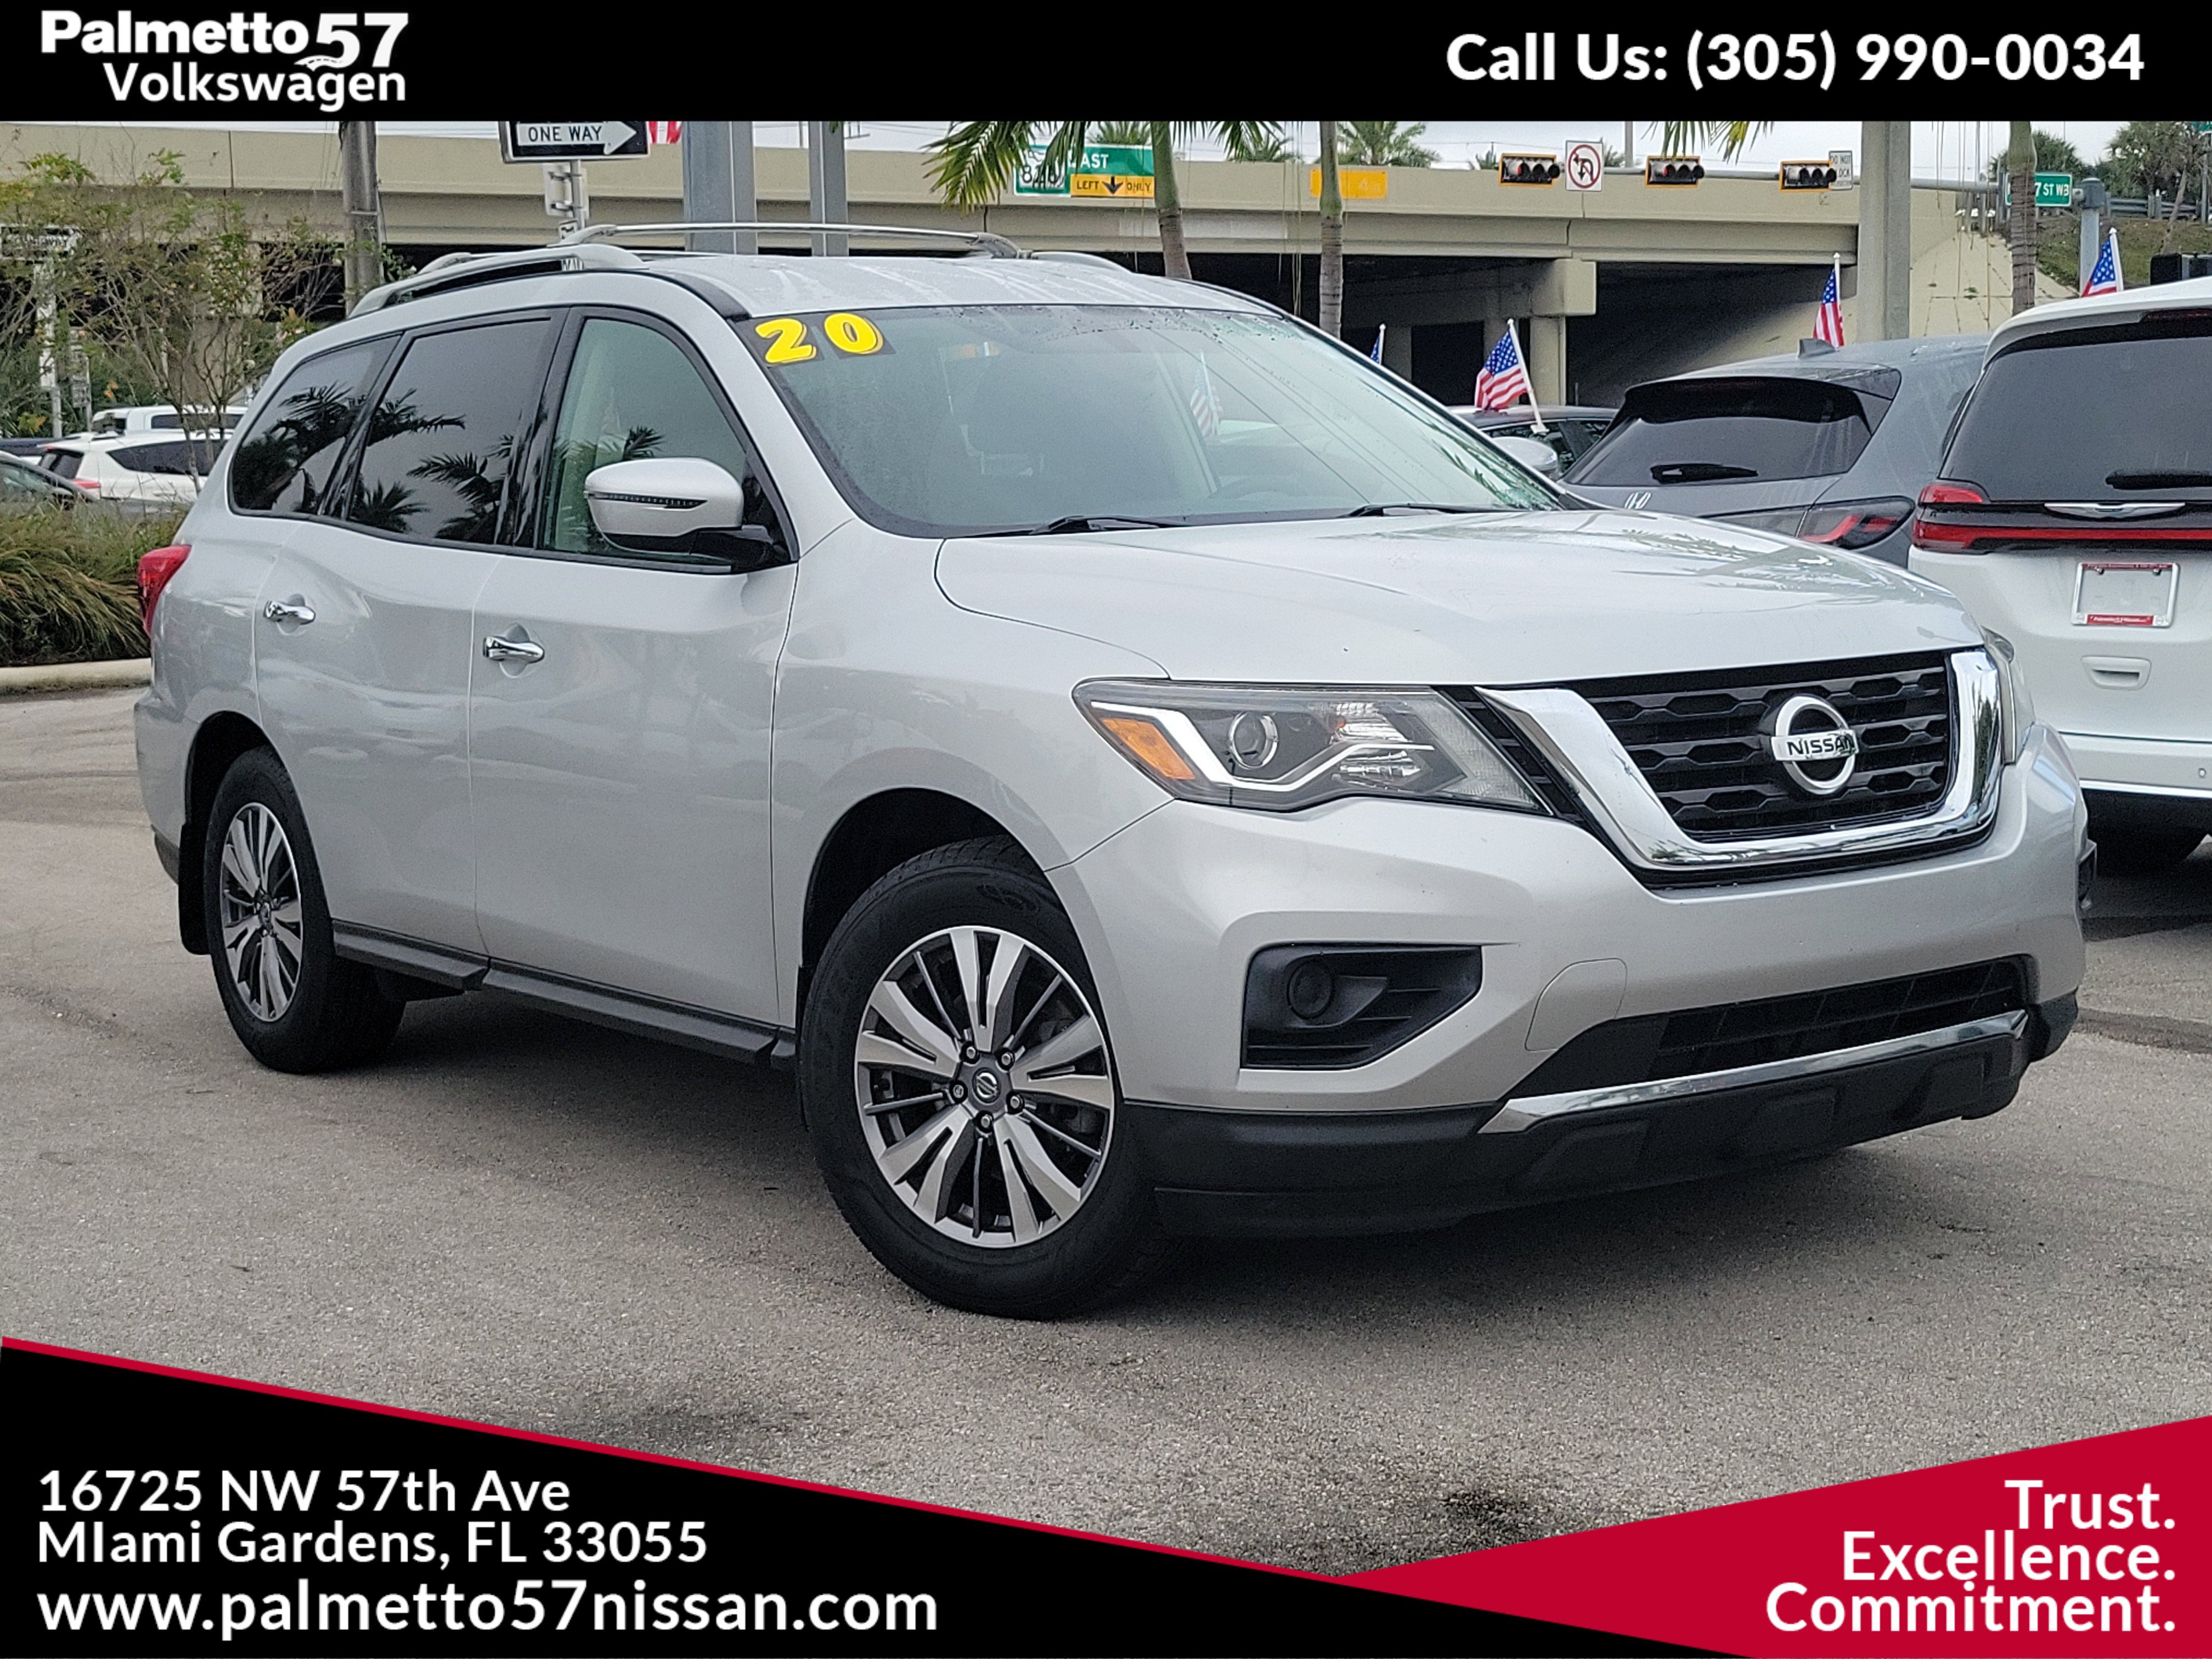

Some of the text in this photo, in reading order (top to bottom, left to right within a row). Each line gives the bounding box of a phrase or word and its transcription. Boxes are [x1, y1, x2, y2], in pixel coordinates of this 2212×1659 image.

[528, 125, 602, 143] ONE WAY
[1076, 180, 1150, 192] LEFT ONLY
[2042, 183, 2054, 196] ST
[2056, 184, 2069, 196] WB
[755, 312, 884, 364] 20
[1786, 732, 1857, 756] NISSAN
